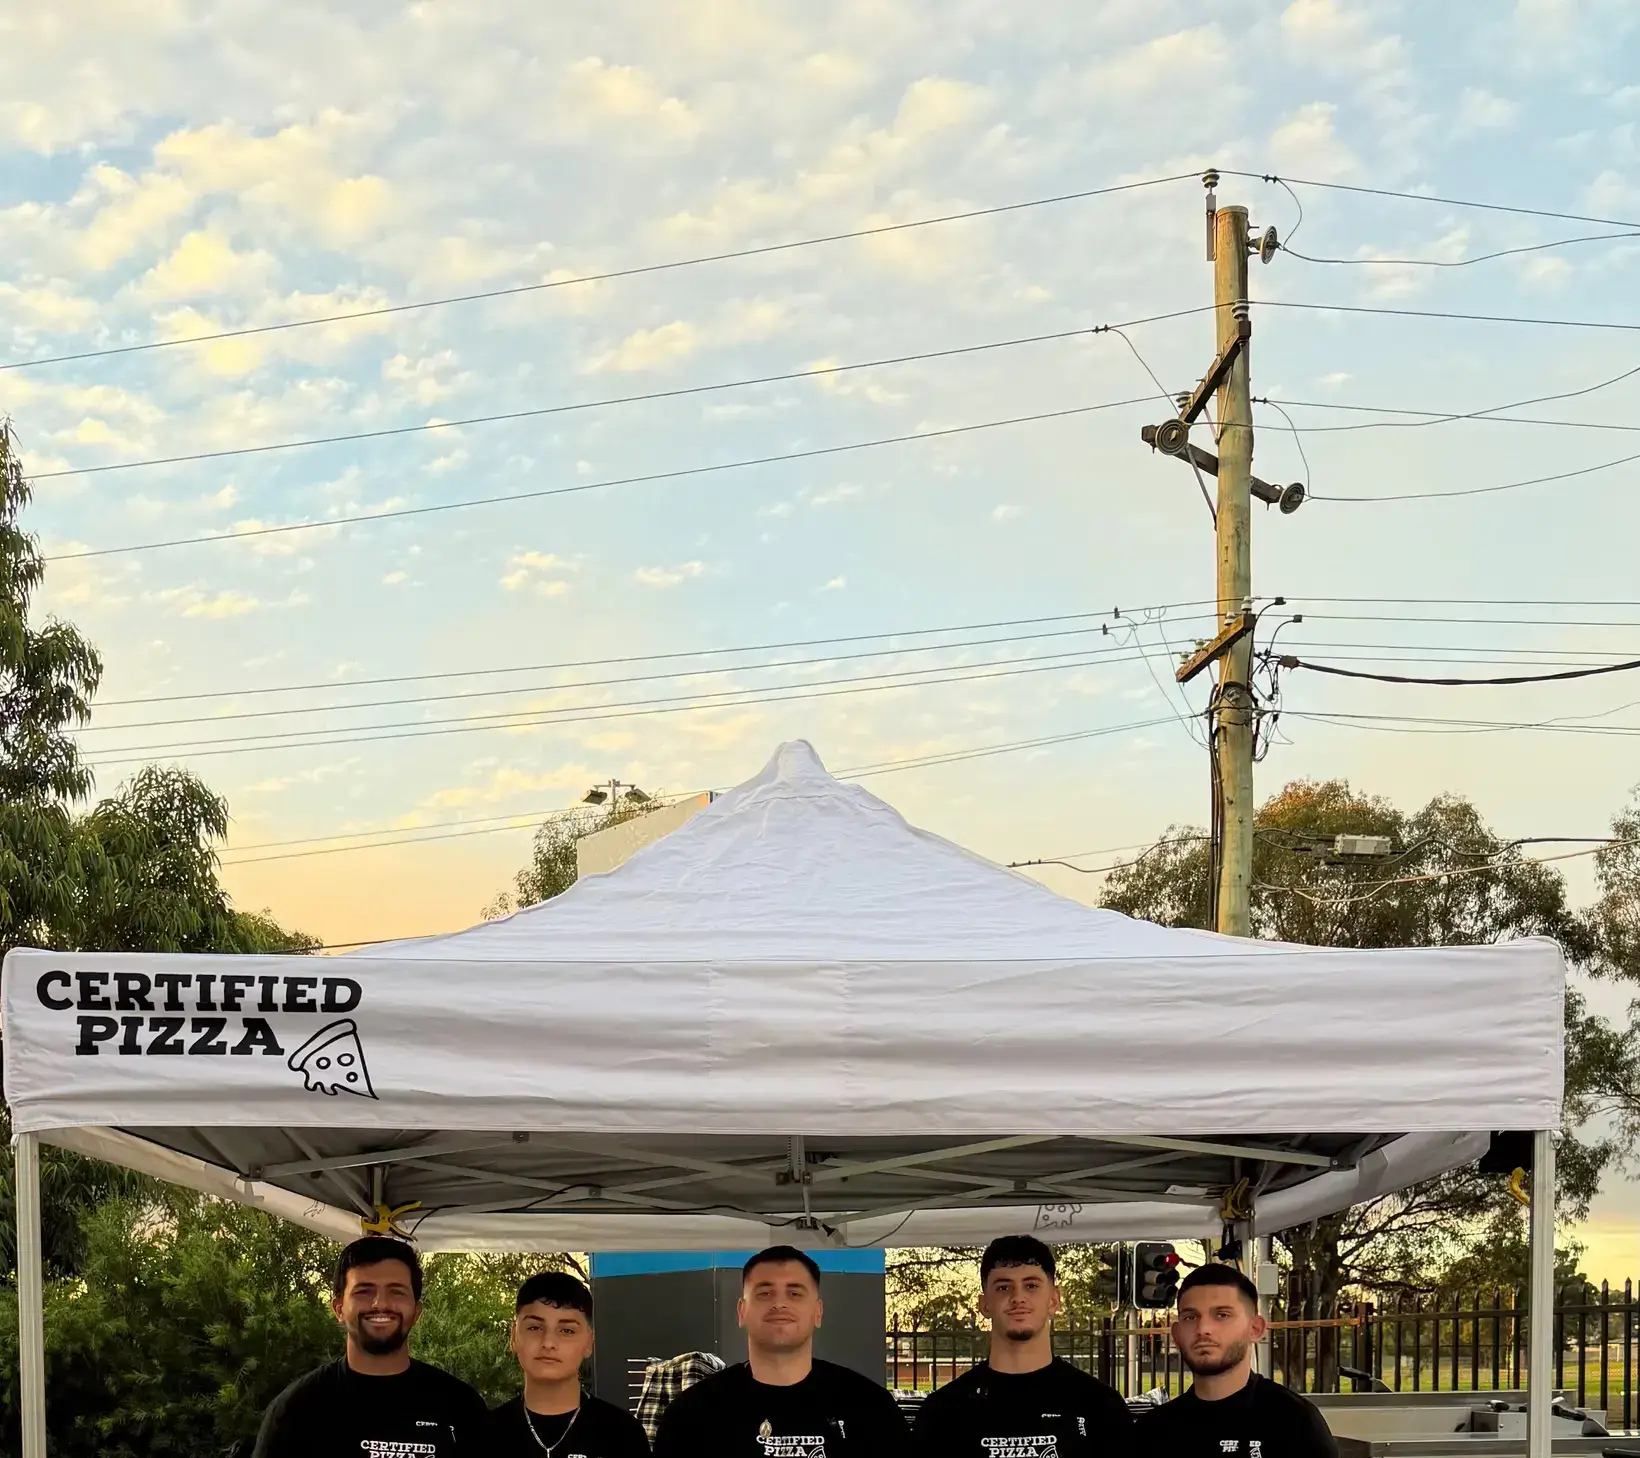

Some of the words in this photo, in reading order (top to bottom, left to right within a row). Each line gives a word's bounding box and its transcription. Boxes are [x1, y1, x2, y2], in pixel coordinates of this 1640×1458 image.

[36, 970, 363, 1013] CERTIFIED
[75, 1016, 285, 1056] PIZZA
[756, 1435, 825, 1446] CERTIFIED
[981, 1435, 1058, 1447] CERTIFIED
[360, 1440, 436, 1454] CERTIFIED
[764, 1446, 808, 1457] PIZZA
[989, 1447, 1039, 1458] PIZZA
